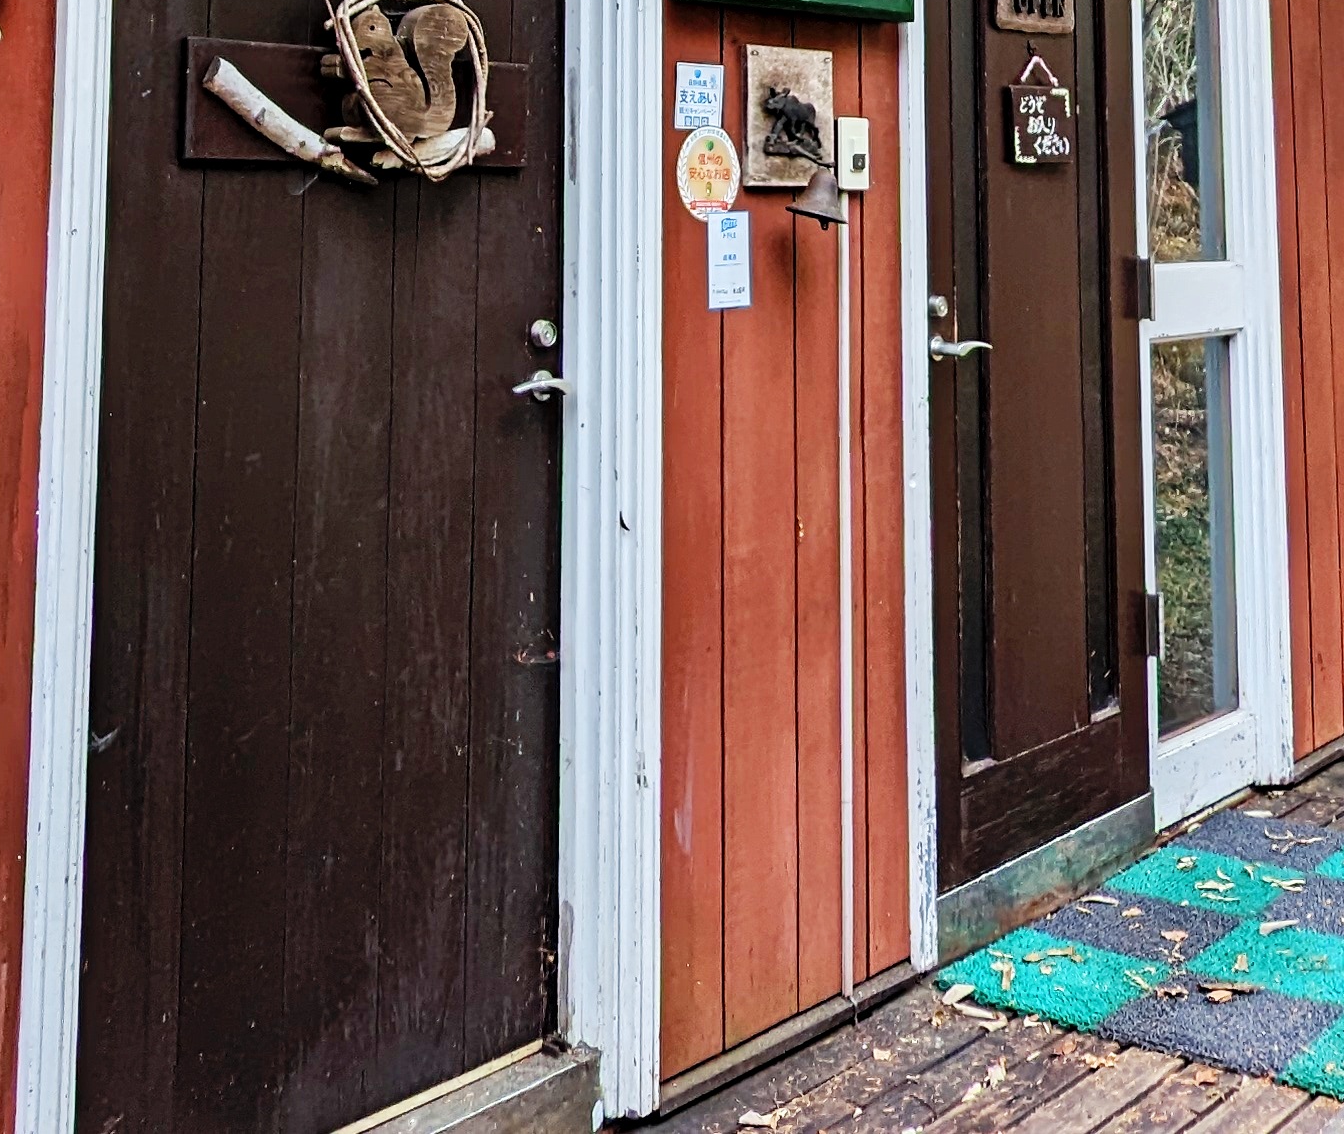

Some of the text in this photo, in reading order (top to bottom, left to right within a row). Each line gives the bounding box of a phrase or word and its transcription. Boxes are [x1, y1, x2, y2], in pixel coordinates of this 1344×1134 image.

[679, 89, 717, 104] 支えあい
[1019, 95, 1047, 114] どうぞ
[1027, 115, 1056, 135] お入り
[1033, 133, 1070, 156] ください
